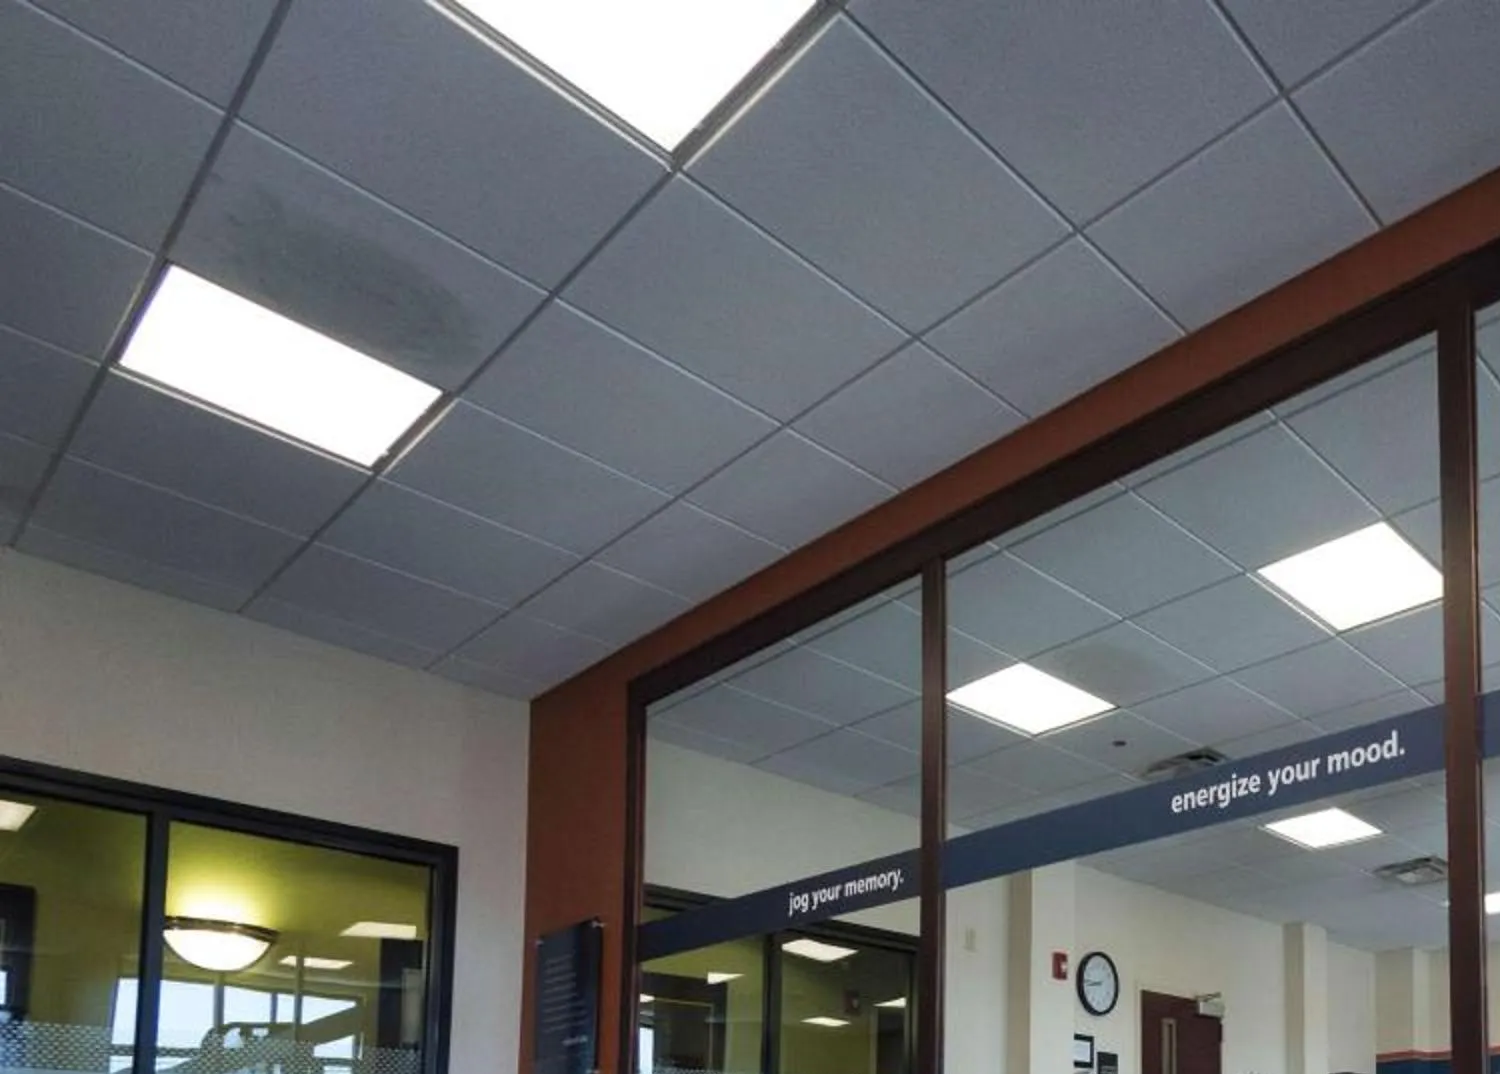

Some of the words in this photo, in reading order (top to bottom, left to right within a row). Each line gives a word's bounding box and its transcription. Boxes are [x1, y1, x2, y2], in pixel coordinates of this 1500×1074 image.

[1171, 773, 1261, 813] energize
[1267, 757, 1320, 795] your
[1326, 729, 1406, 775] mood.
[788, 891, 809, 917] jog
[811, 884, 842, 910] your
[843, 868, 904, 891] memory.
